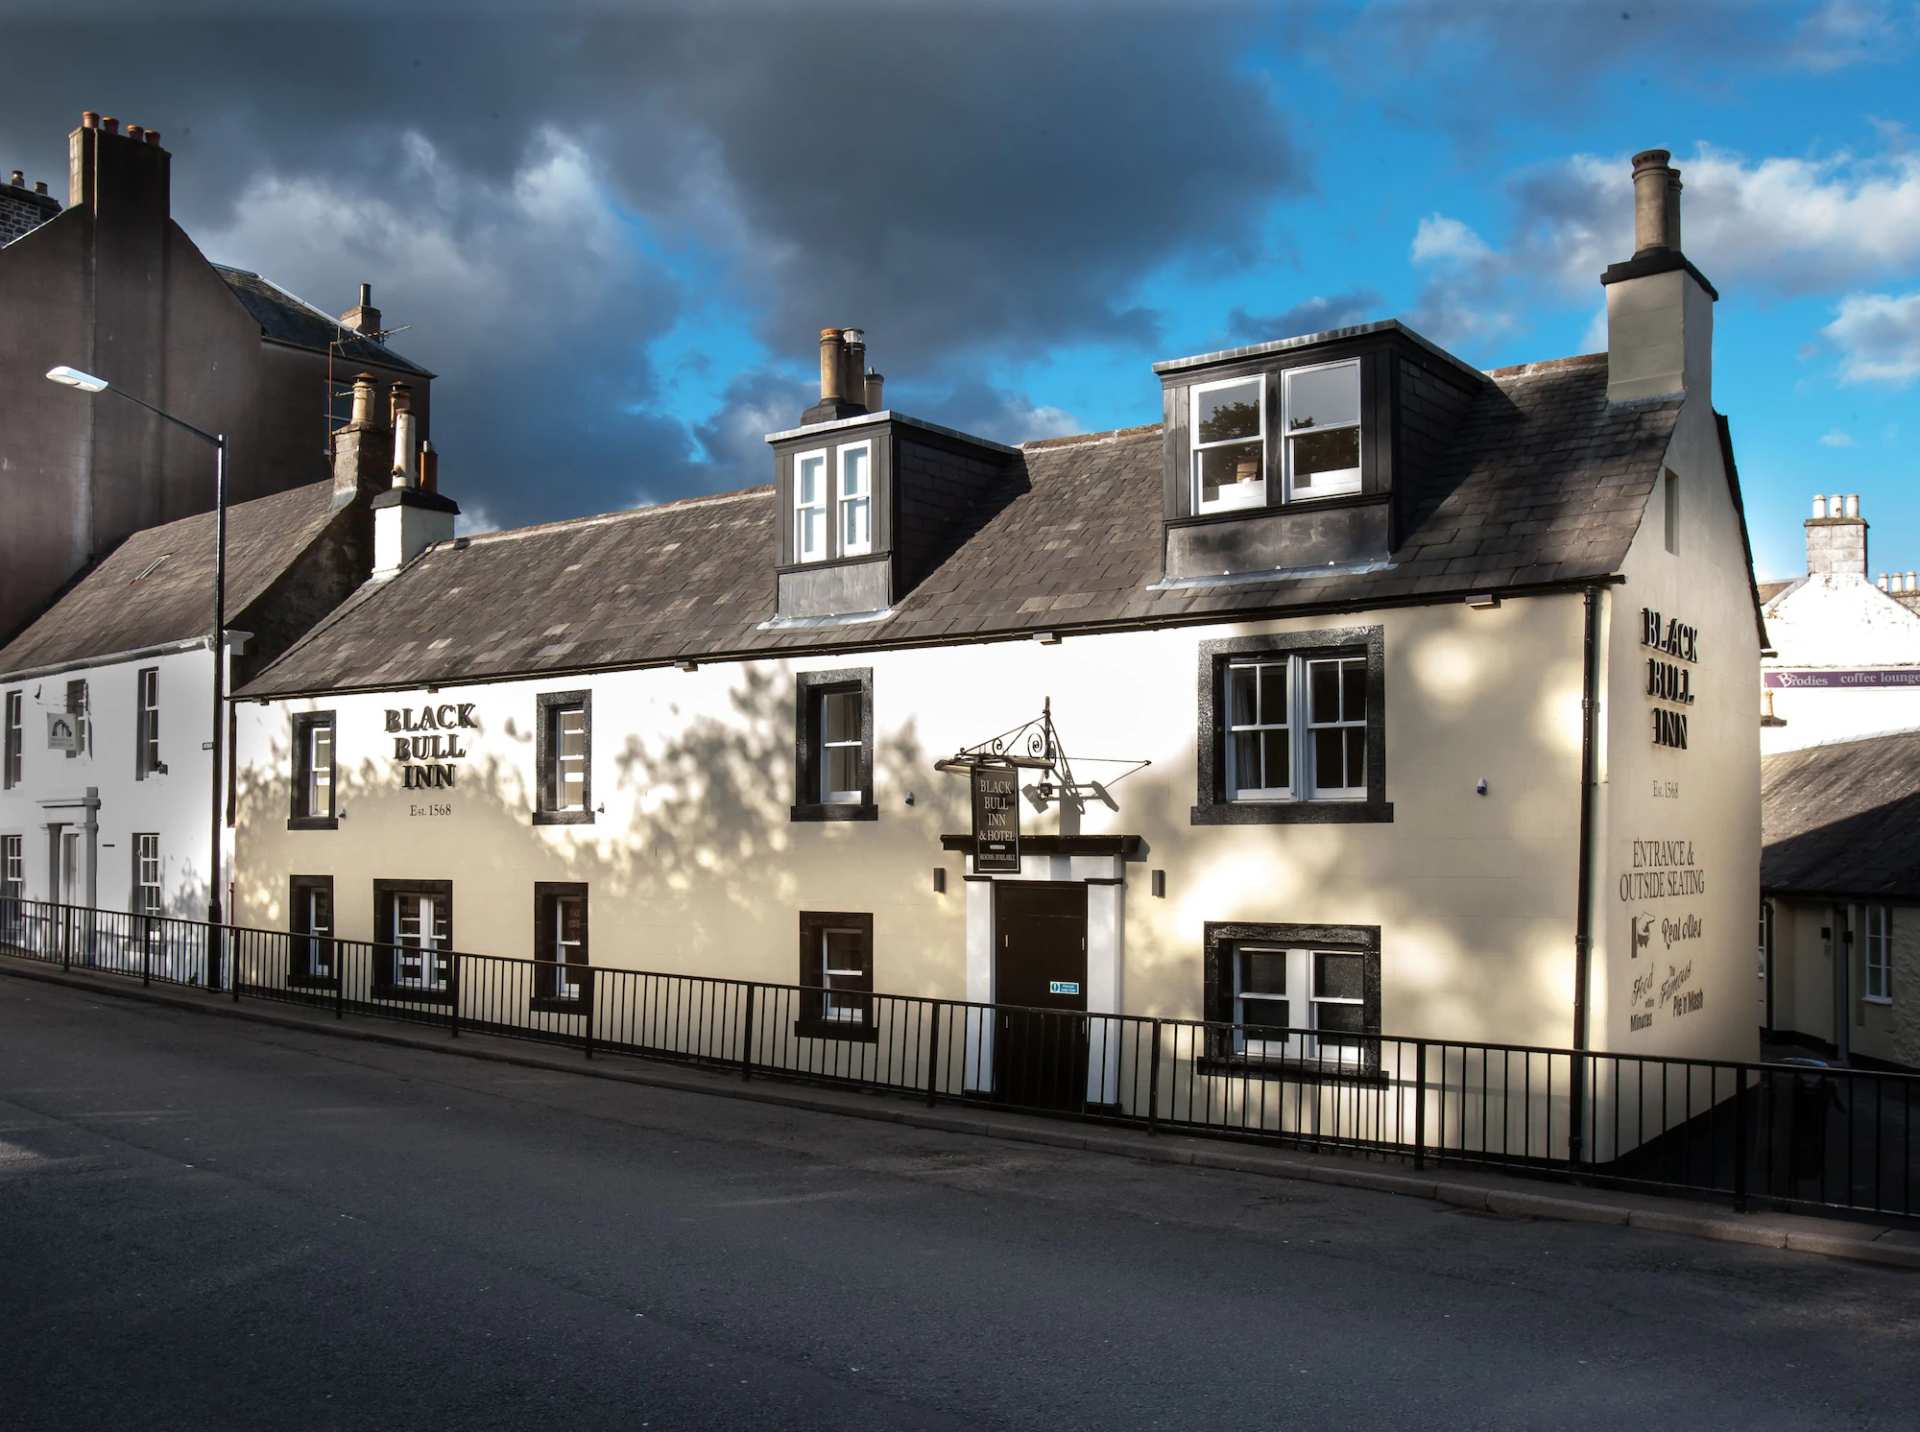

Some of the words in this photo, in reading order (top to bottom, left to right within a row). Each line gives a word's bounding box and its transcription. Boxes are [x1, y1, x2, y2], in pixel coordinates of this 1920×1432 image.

[1641, 607, 1698, 664] BLACK
[1646, 658, 1694, 705] BULL
[1776, 672, 1829, 687] Brodies
[1840, 673, 1877, 684] coffee
[384, 703, 478, 733] BLACK
[1652, 707, 1687, 750] INN
[393, 734, 467, 761] BULL
[401, 764, 457, 789] INN
[980, 779, 1012, 794] BLACK
[429, 804, 452, 817] 1568
[984, 796, 1009, 810] BULL
[988, 813, 1006, 826] INN
[979, 830, 986, 841] &
[987, 830, 1016, 841] HOTEL
[1633, 839, 1685, 868] ENTRANCE
[1687, 841, 1694, 866] &
[1620, 871, 1664, 902] OUTSIDE
[1667, 869, 1705, 897] SEATING
[1661, 917, 1680, 950] Real
[1682, 914, 1702, 940] Ales
